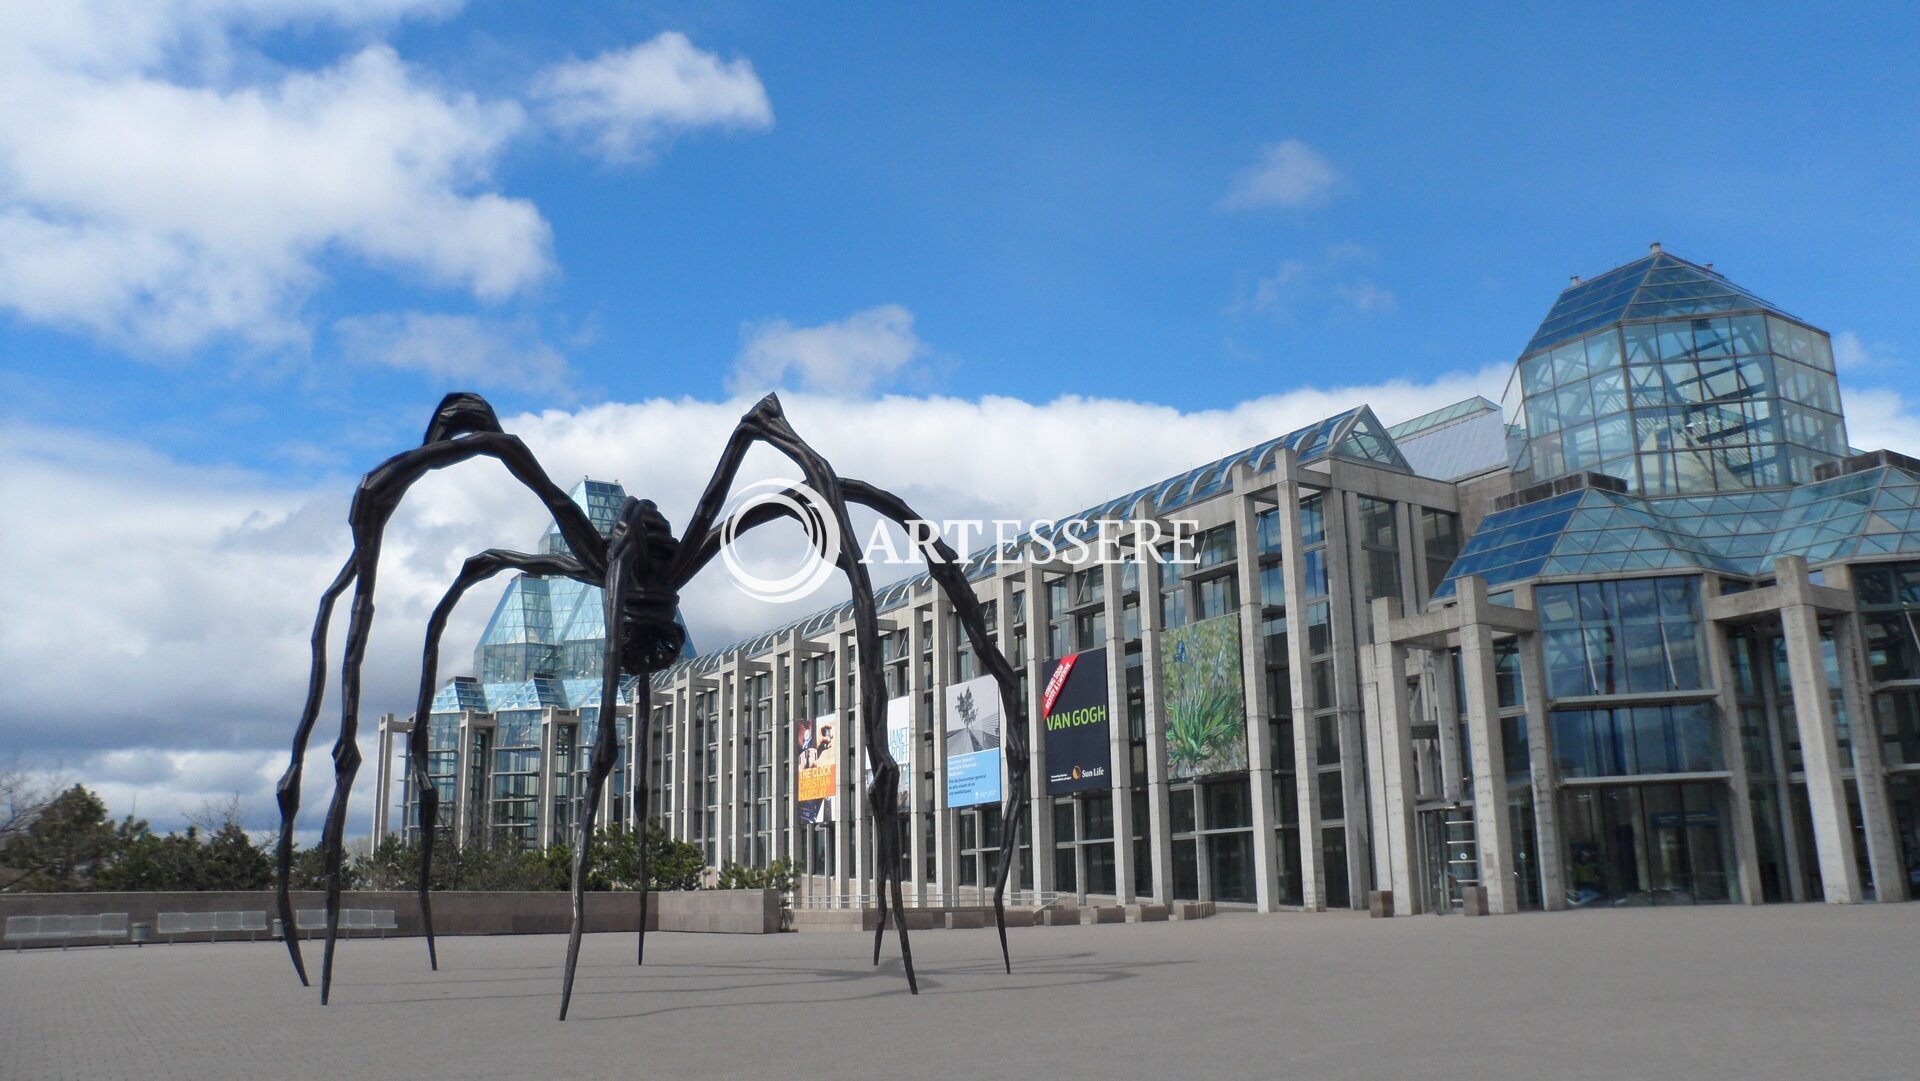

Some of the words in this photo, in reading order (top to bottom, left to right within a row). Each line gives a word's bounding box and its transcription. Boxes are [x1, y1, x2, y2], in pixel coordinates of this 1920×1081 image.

[1046, 711, 1071, 731] VAN
[1072, 704, 1106, 727] GOGH
[889, 727, 909, 747] JANET
[799, 768, 811, 779] THE
[812, 765, 832, 778] CLOCK
[1081, 769, 1093, 778] Sun
[1093, 766, 1105, 777] Life
[799, 776, 831, 790] CHRISTIAN
